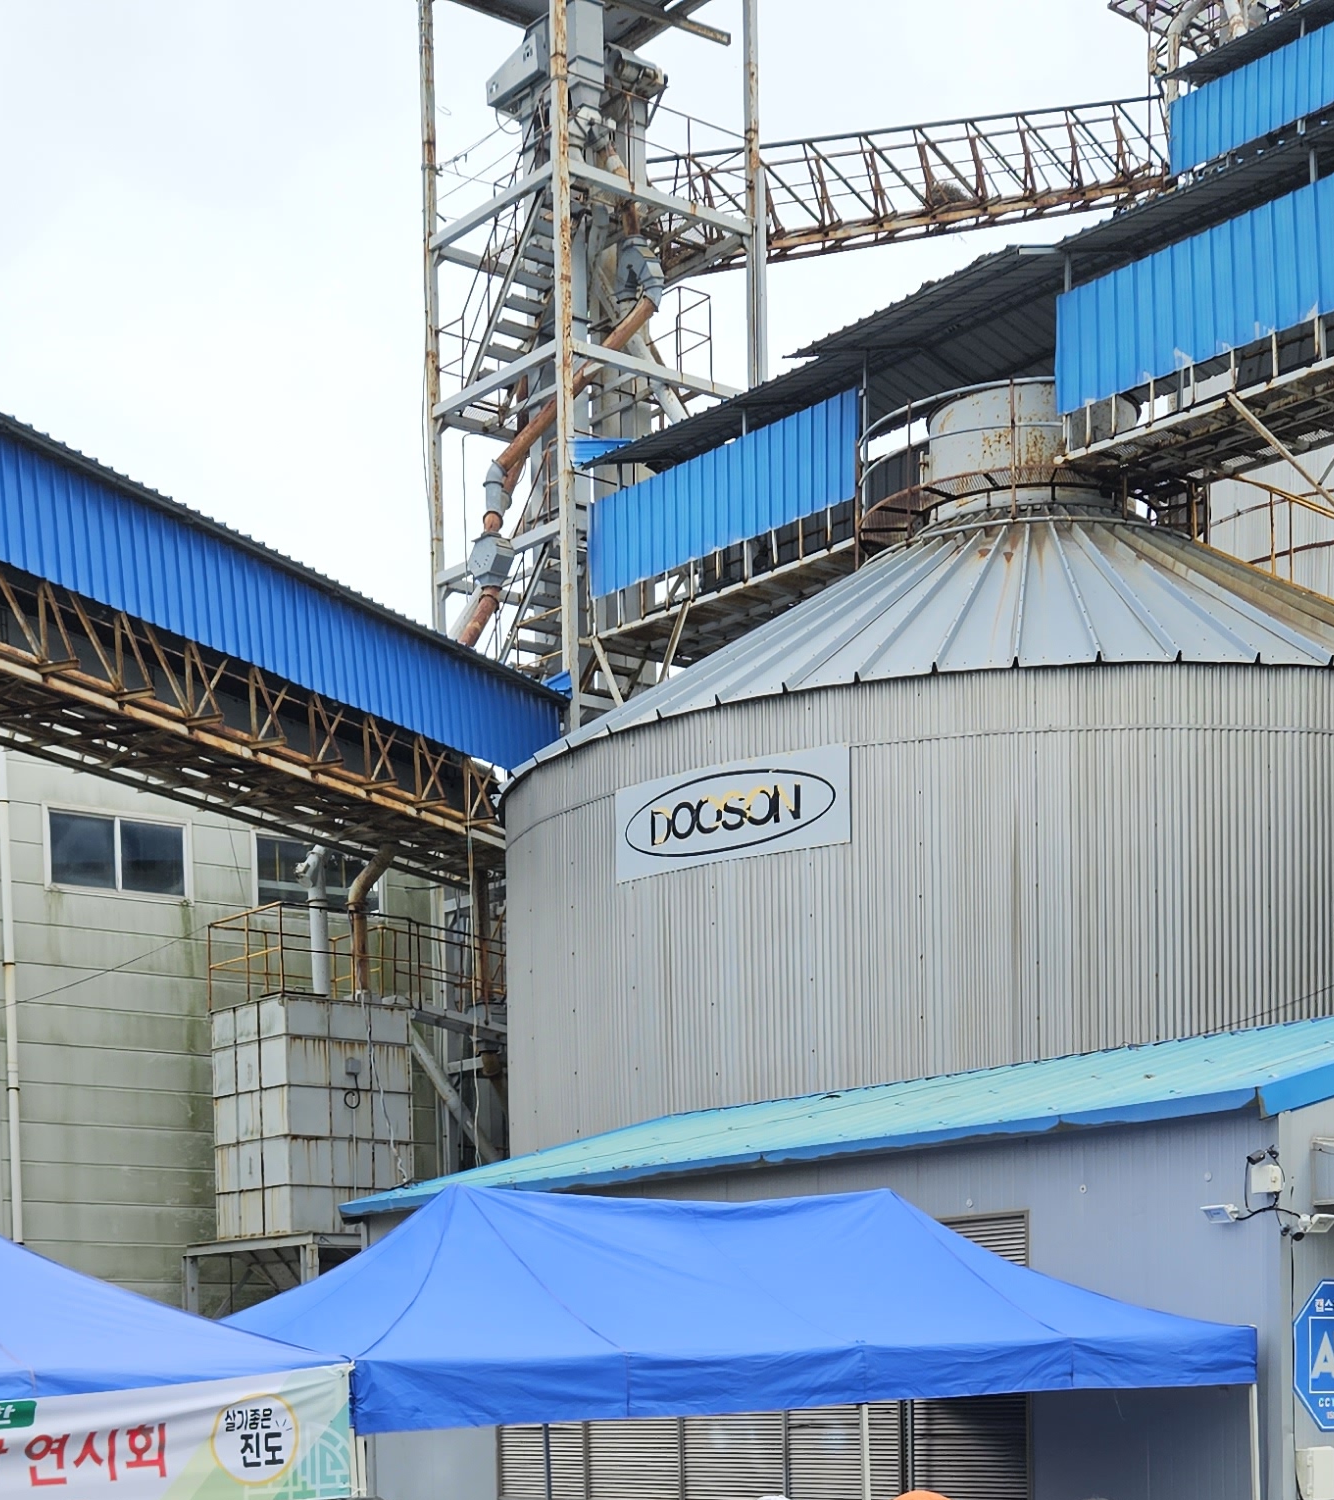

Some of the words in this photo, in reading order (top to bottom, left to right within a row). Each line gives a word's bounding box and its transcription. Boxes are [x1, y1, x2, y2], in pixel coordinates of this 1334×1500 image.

[224, 1408, 273, 1432] 살기좋은
[26, 1423, 169, 1488] 연시회
[240, 1432, 284, 1468] 진도
